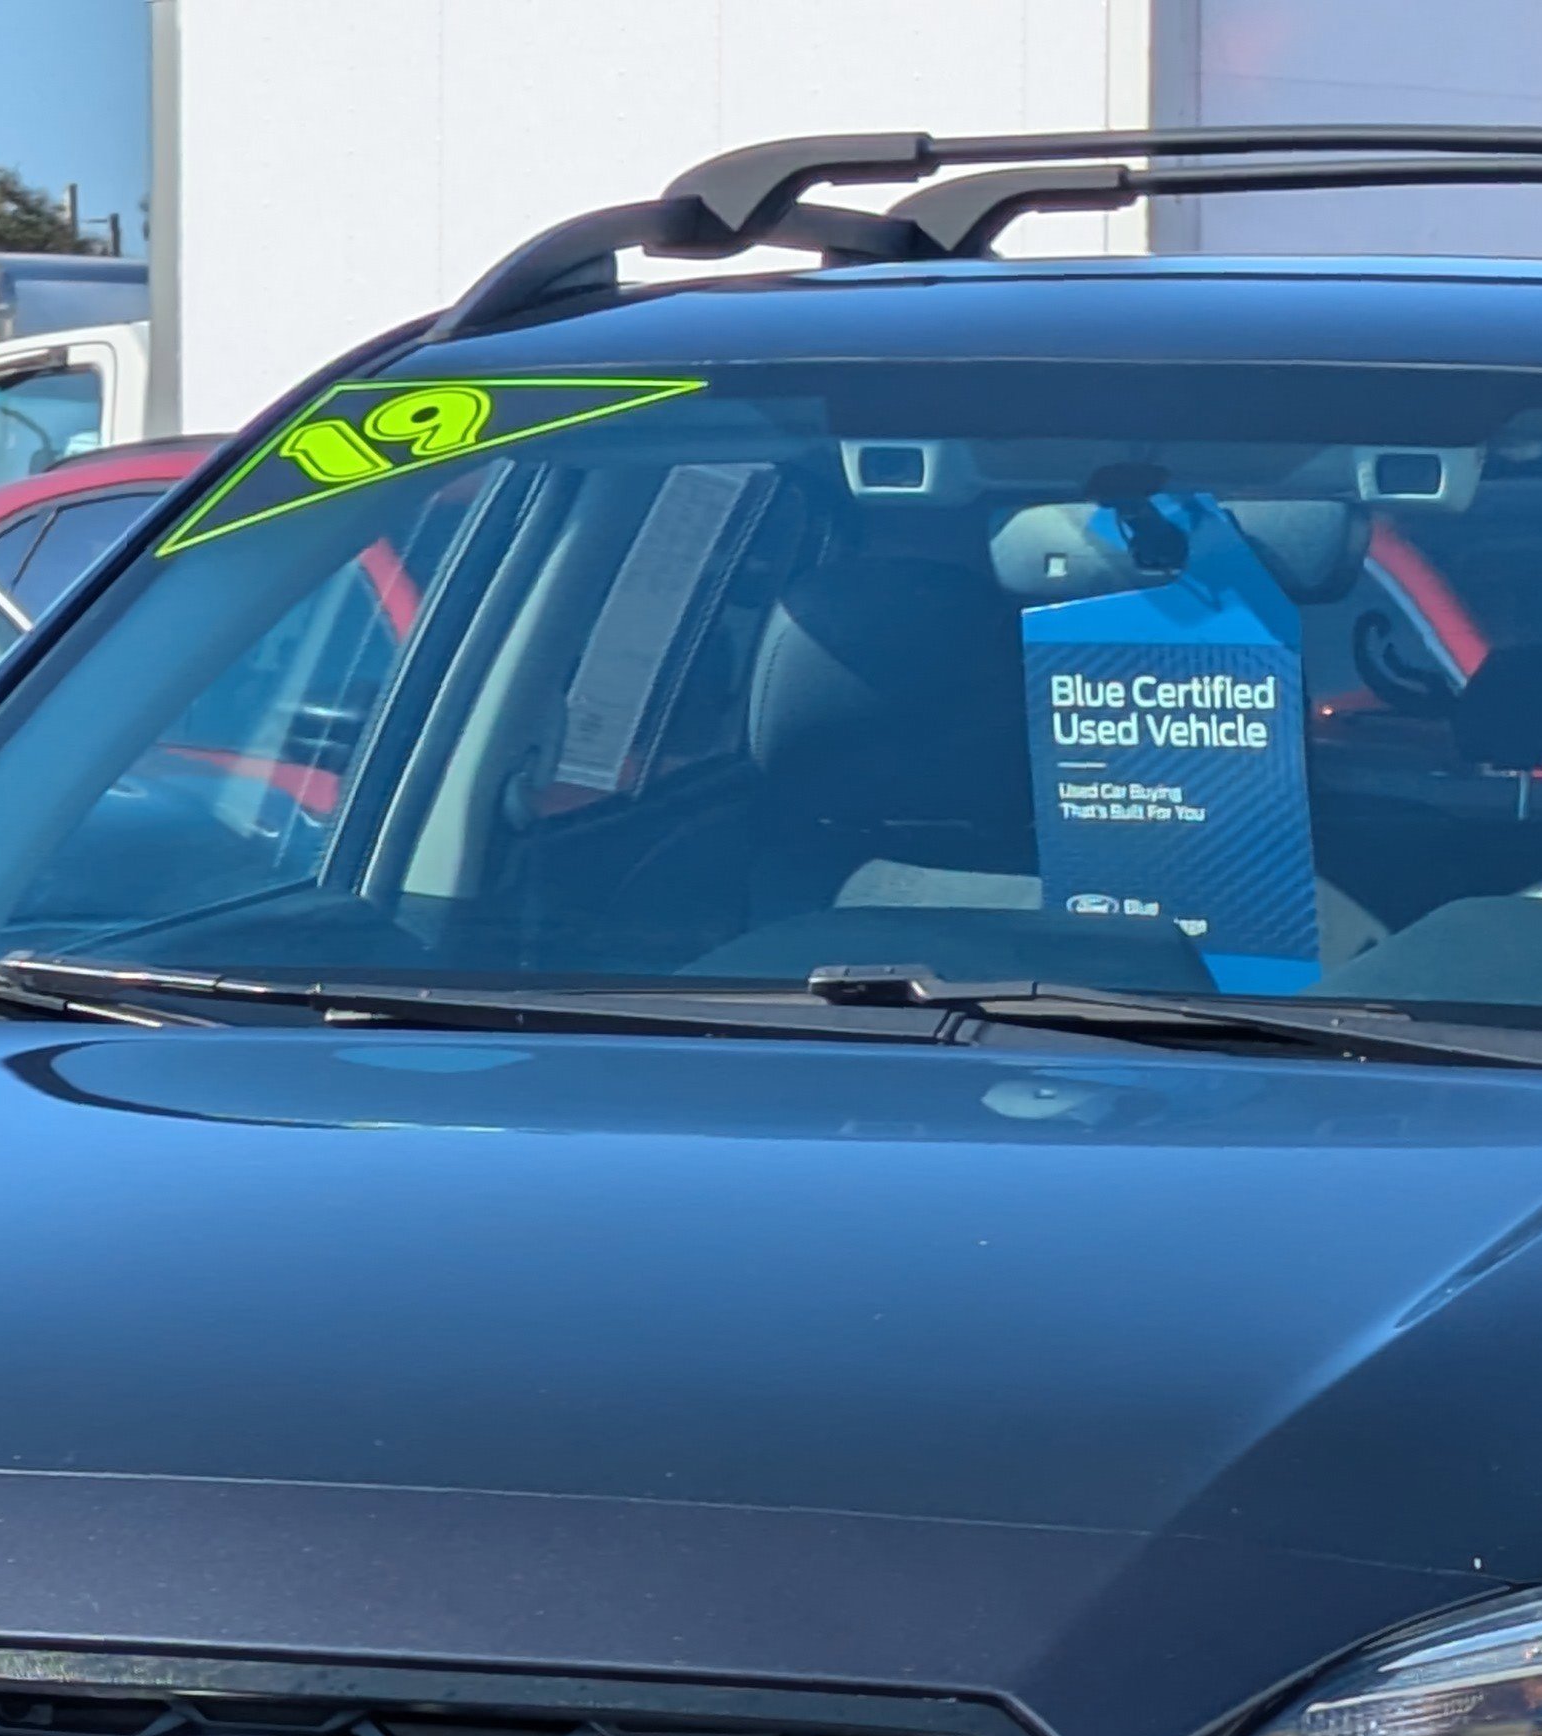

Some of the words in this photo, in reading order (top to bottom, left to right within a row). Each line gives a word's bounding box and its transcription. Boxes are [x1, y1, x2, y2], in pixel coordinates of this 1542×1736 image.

[279, 386, 492, 483] 19
[1051, 674, 1126, 708] Blue
[1132, 674, 1276, 709] Certified
[1053, 712, 1139, 745] Used
[1146, 713, 1268, 748] Vehicle
[1100, 782, 1127, 799] Car
[1128, 783, 1183, 803] Buying
[1147, 804, 1172, 820] For
[1174, 805, 1206, 821] You
